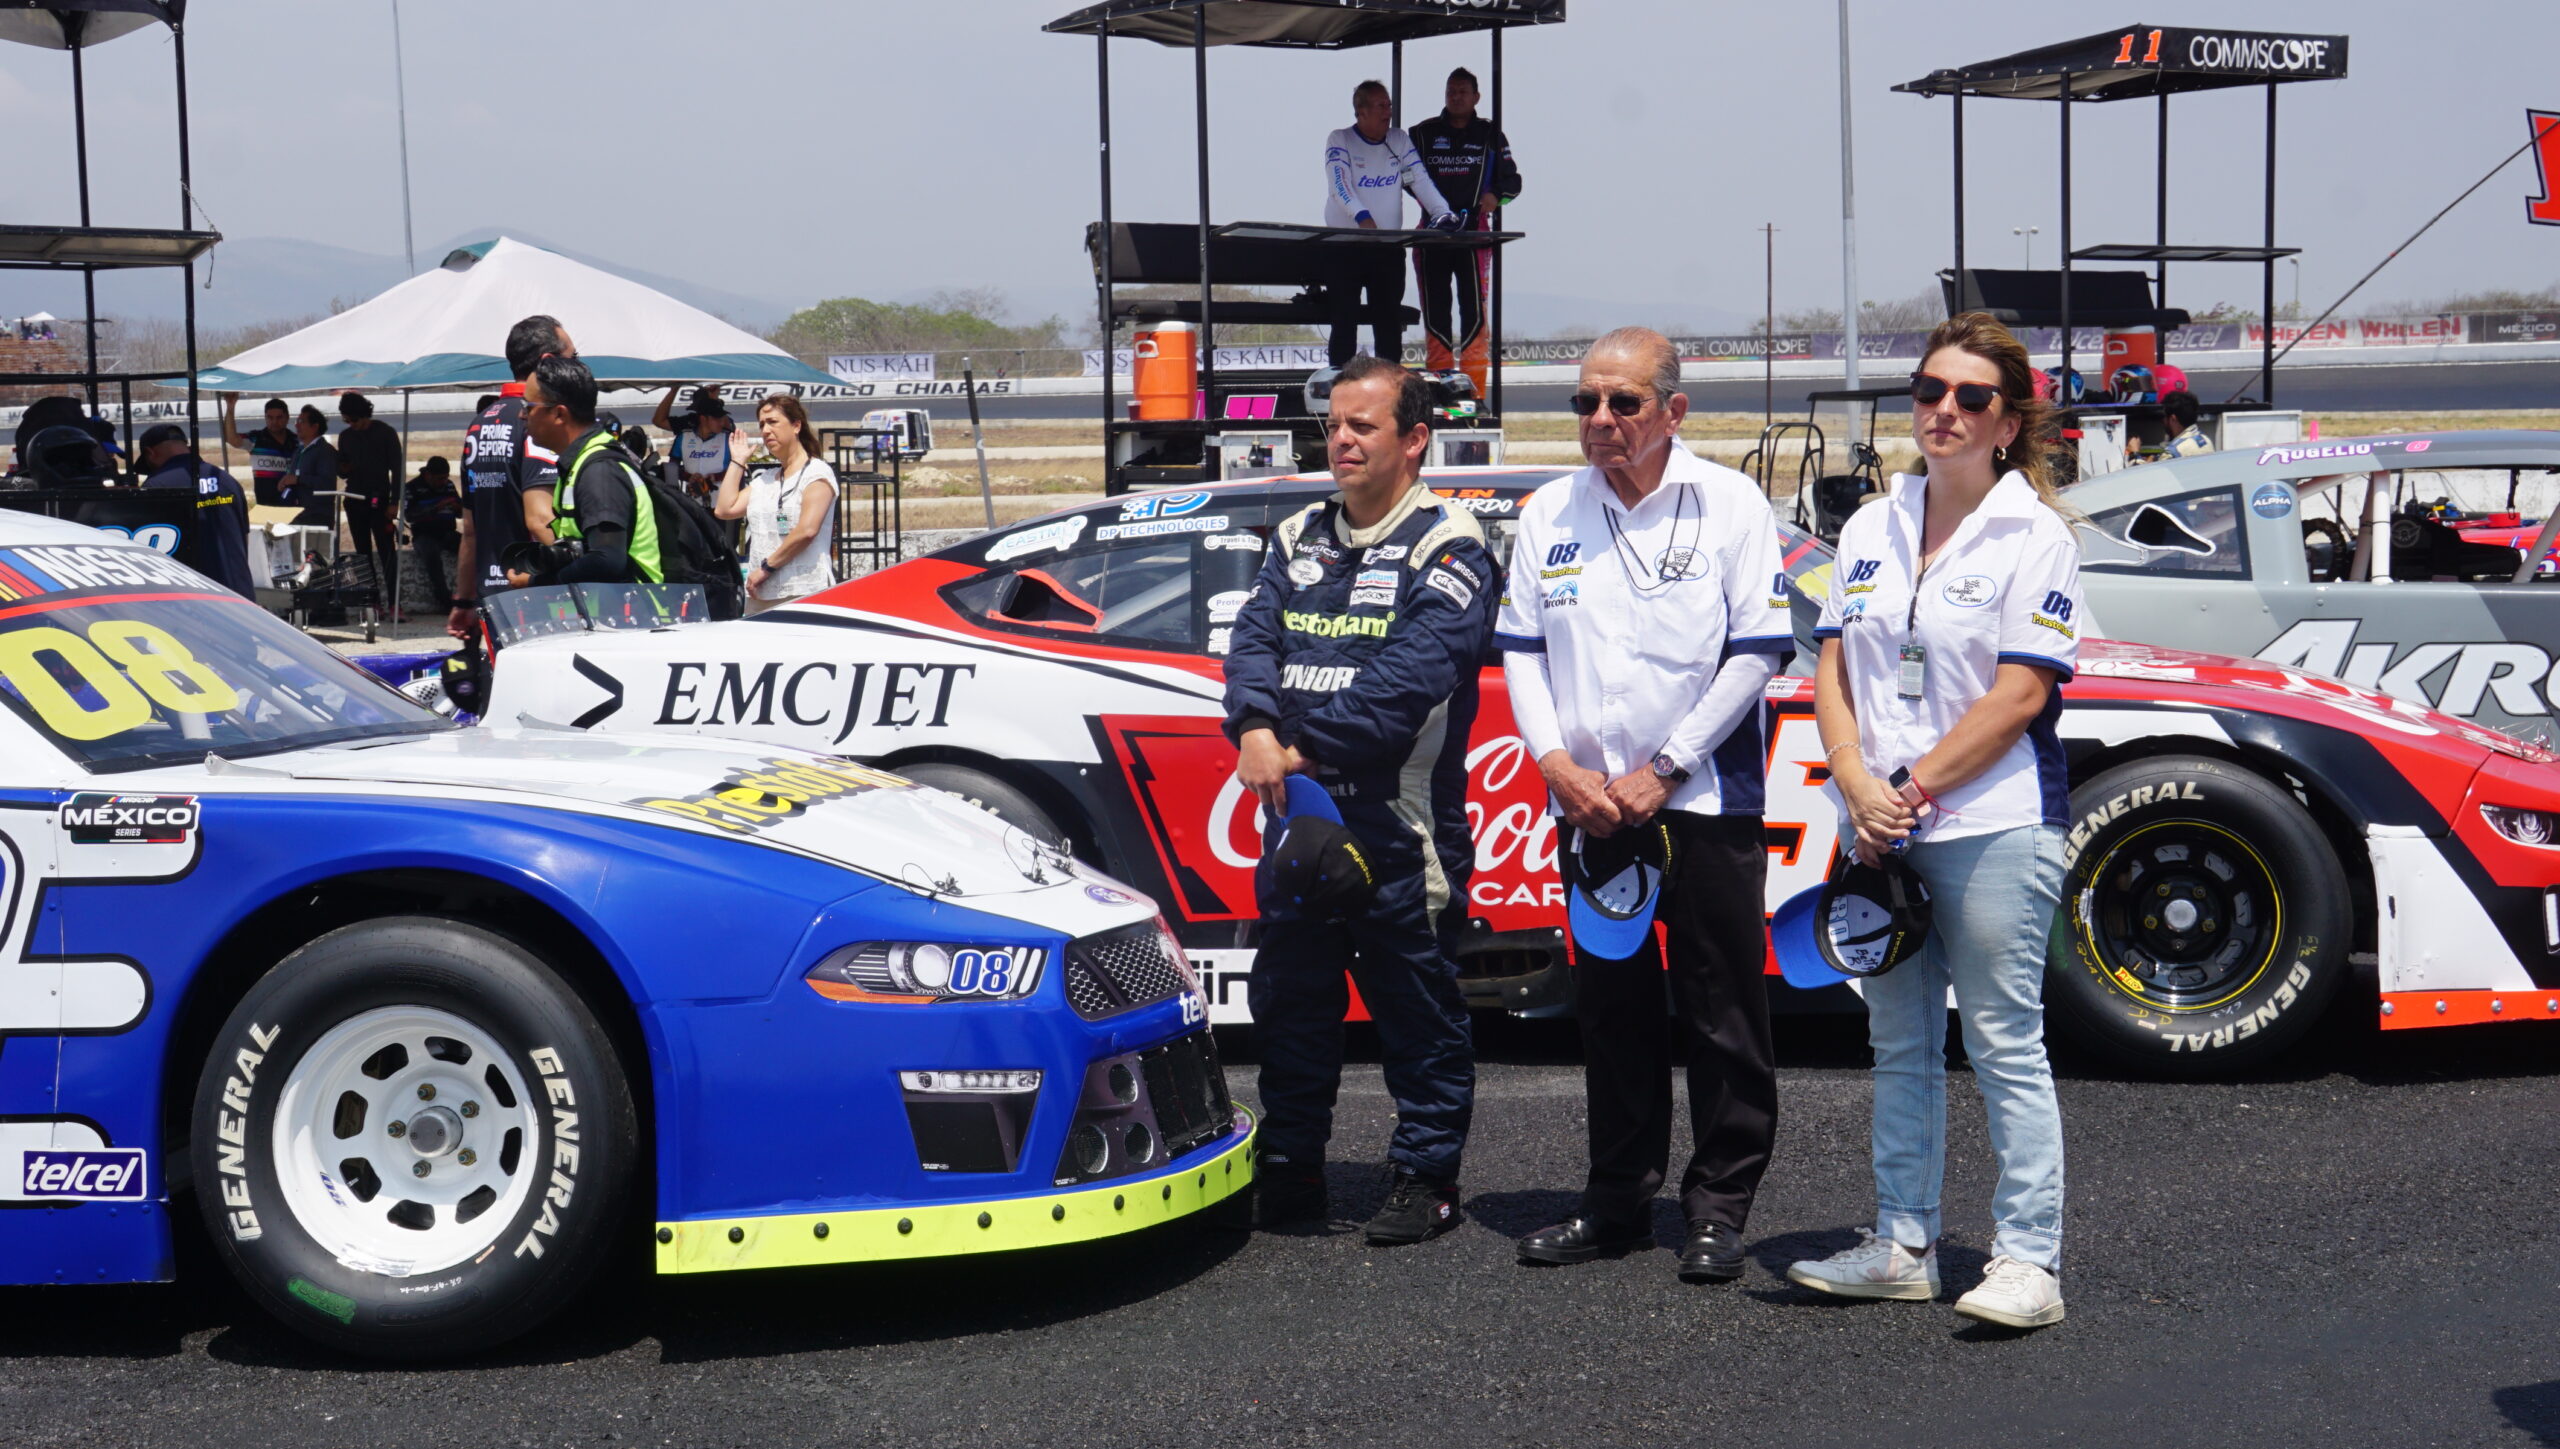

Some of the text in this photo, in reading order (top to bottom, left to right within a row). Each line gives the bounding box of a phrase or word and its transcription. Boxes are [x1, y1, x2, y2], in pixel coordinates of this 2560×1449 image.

[2189, 36, 2326, 69] COMMSCOPE
[1358, 172, 1398, 187] telcel
[2164, 328, 2222, 349] elcel
[833, 354, 929, 375] NUS-KÁH
[679, 386, 768, 402] SPER
[480, 424, 513, 441] PRIME
[478, 440, 514, 458] SPORTS
[2257, 445, 2371, 466] ROGELIO
[2252, 496, 2292, 508] ALPHA
[1121, 517, 1227, 538] TECHNOLOGIES
[1547, 543, 1581, 567] 08
[13, 547, 223, 593] NASCAR
[1452, 560, 1481, 590] NASCAR
[1848, 558, 1882, 583] 08
[2042, 590, 2073, 623] 08
[1282, 609, 1395, 638] estoflam®
[0, 620, 240, 741] 08
[653, 662, 976, 746] EMCJET
[65, 804, 192, 826] MÉXICO
[2064, 781, 2205, 869] GENERAL
[115, 828, 142, 837] SERIES
[948, 948, 1014, 996] 08
[2161, 960, 2312, 1053] GENERAL
[216, 1022, 282, 1241] GENERAL
[513, 1046, 581, 1260] GENERAL
[25, 1156, 139, 1192] telcel
